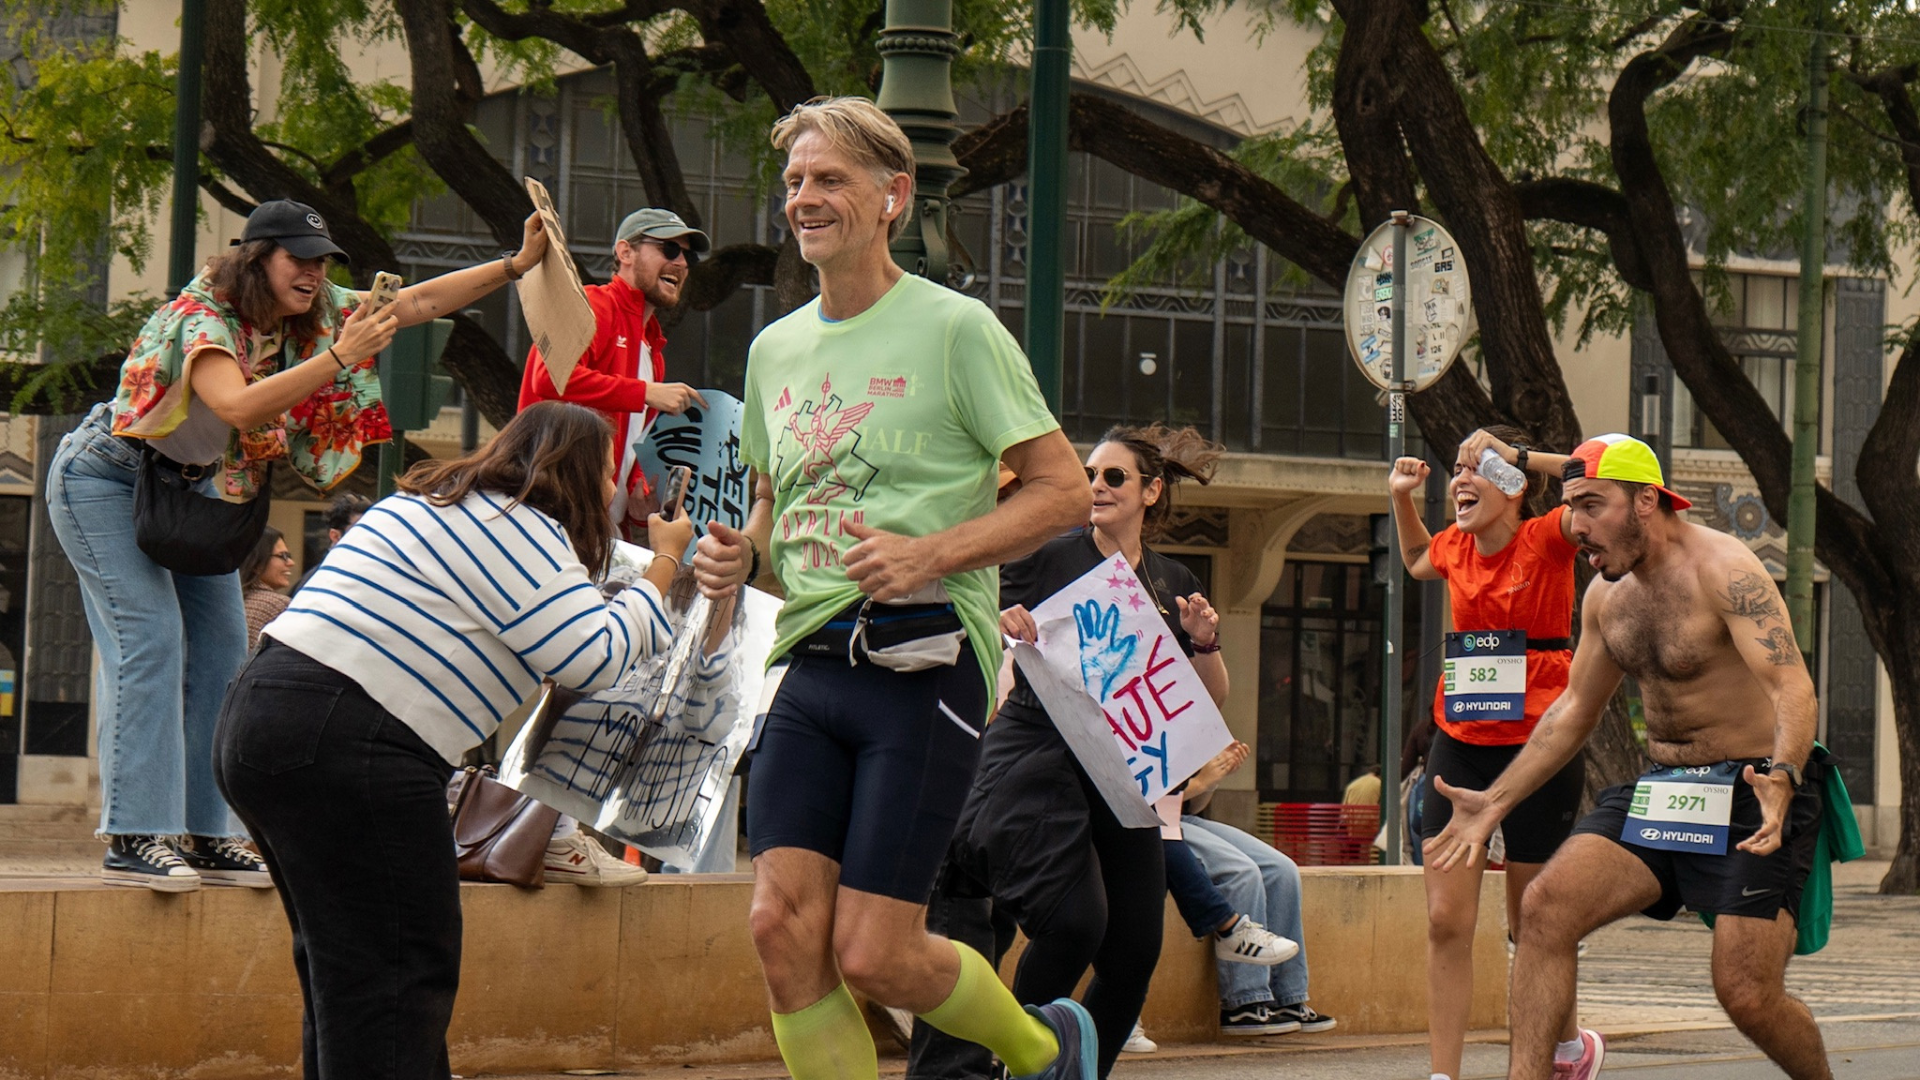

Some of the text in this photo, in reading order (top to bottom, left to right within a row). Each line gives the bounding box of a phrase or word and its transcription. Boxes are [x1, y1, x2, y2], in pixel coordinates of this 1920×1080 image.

[870, 378, 892, 387] BMW
[867, 390, 905, 399] MARATHON
[1476, 633, 1500, 650] edp
[1469, 667, 1497, 682] 582
[1466, 701, 1511, 711] HYUNDAI
[1703, 786, 1729, 795] OYSHO
[1667, 794, 1706, 812] 2971
[1662, 831, 1713, 844] HYUNDAI
[568, 853, 586, 866] N
